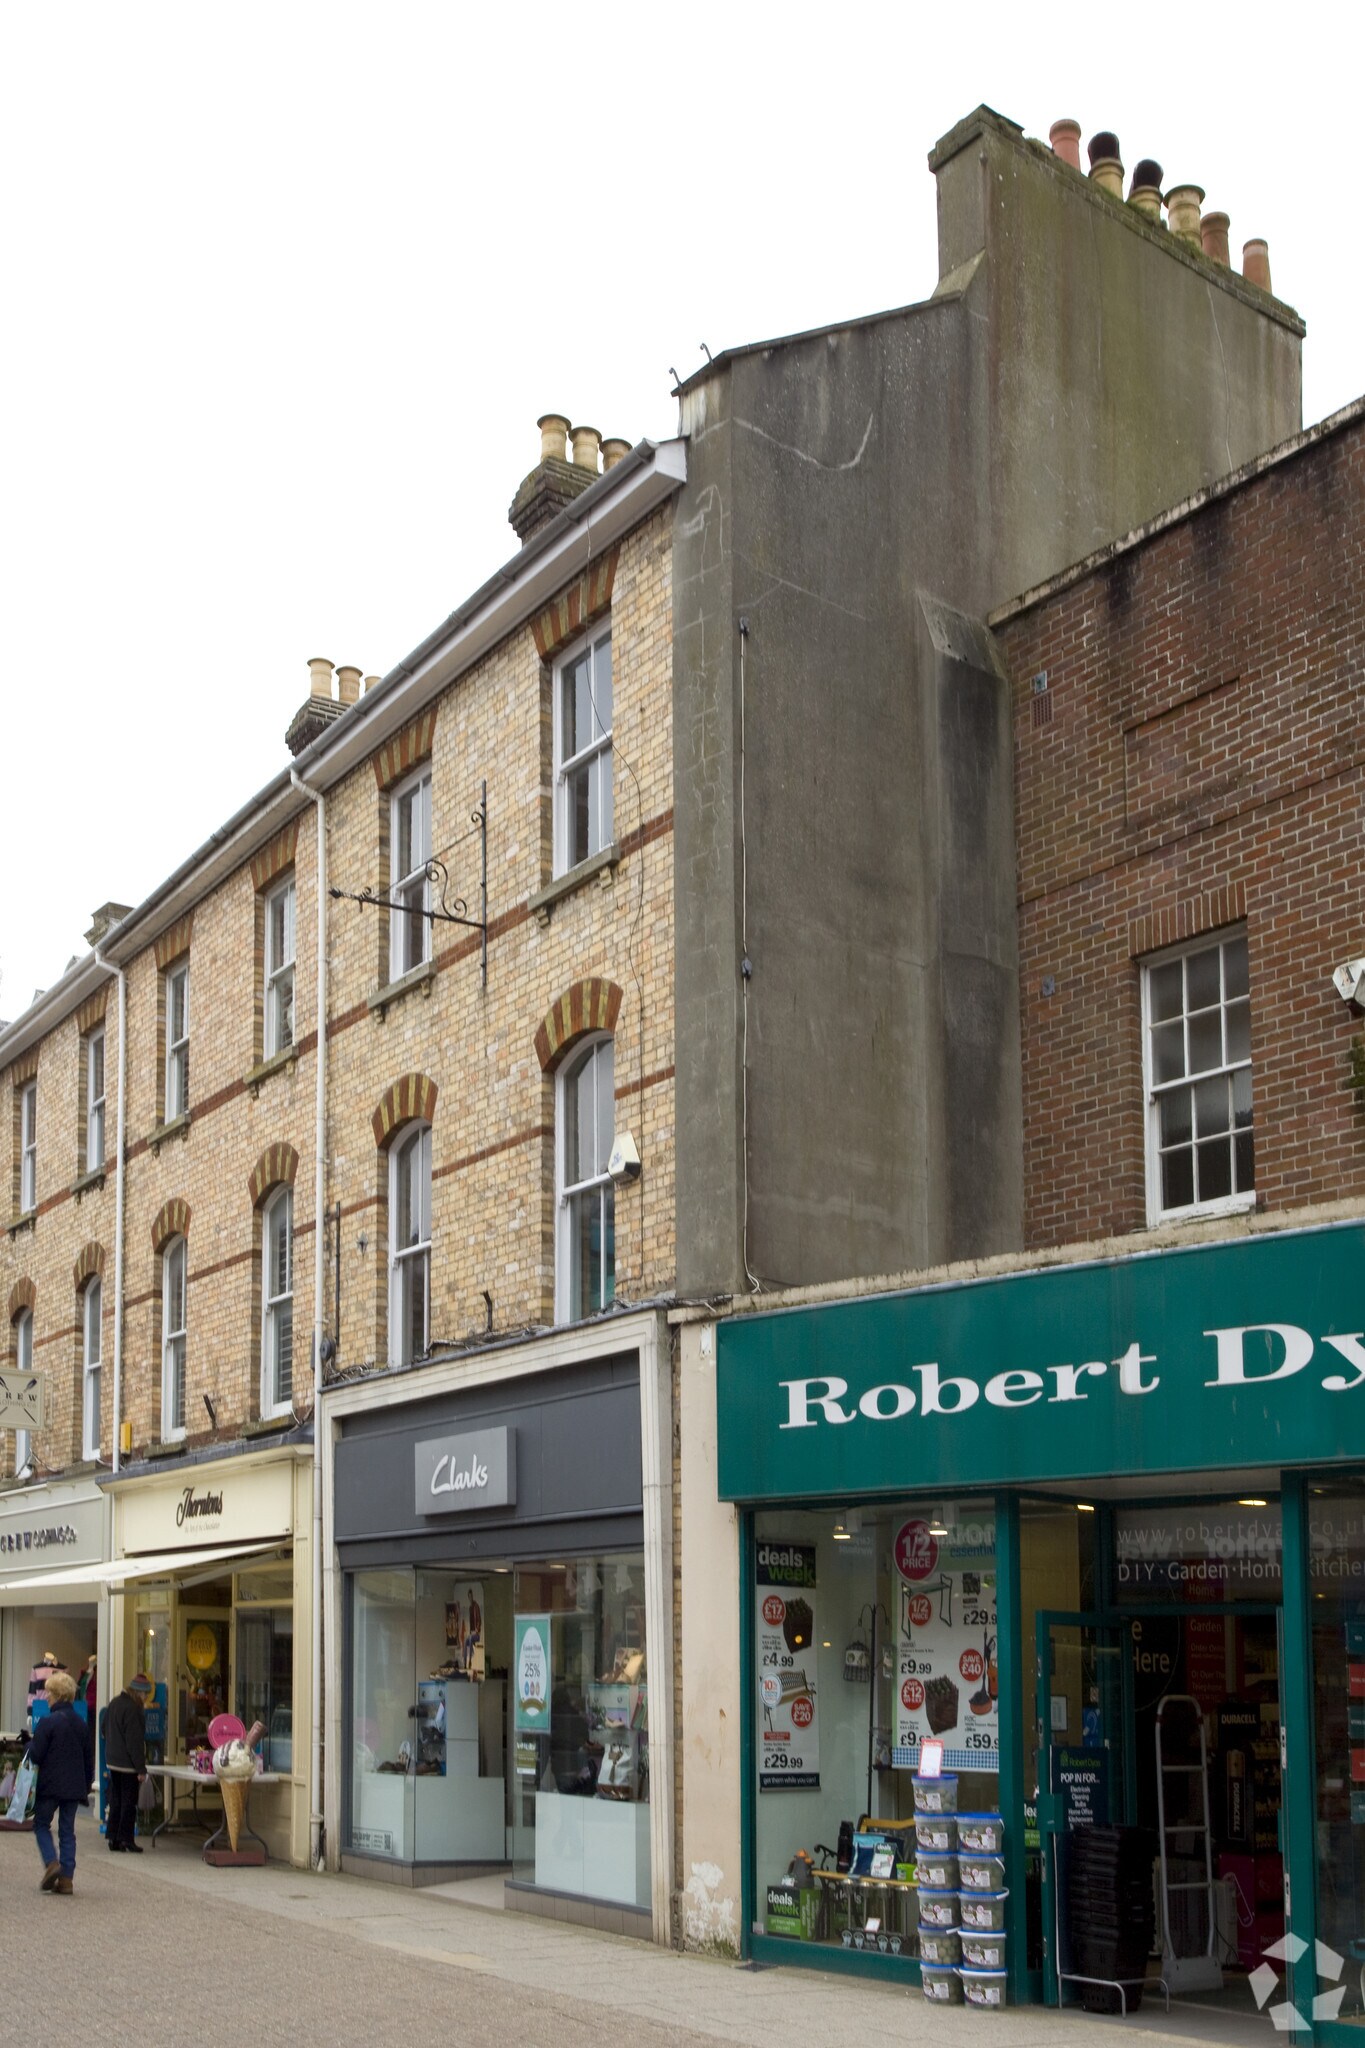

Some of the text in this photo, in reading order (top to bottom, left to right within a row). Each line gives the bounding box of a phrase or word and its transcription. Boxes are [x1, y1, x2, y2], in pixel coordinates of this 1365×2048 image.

[779, 1323, 1365, 1429] Robert Dy
[431, 1454, 488, 1495] Clarks
[176, 1487, 223, 1528] Thorntons
[902, 1534, 930, 1557] 1/2
[759, 1546, 803, 1567] deals
[903, 1556, 931, 1568] PRICE
[768, 1565, 813, 1580] week
[1118, 1557, 1365, 1582] DIY Garden Hom Kitche
[764, 1603, 782, 1615] £17
[911, 1599, 928, 1612] 1/2
[963, 1610, 997, 1625] £29.9
[763, 1652, 794, 1667] £4.99
[963, 1655, 979, 1663] SAVE
[524, 1663, 541, 1677] 25%
[901, 1659, 932, 1674] £9.99
[962, 1663, 981, 1674] £40
[903, 1686, 922, 1696] £12
[794, 1710, 811, 1722] £20
[1221, 1714, 1256, 1725] DURACELL
[965, 1733, 999, 1749] £59.9
[764, 1754, 803, 1768] £29.99
[1060, 1772, 1074, 1784] POP
[1074, 1772, 1082, 1784] IN
[768, 1890, 793, 1906] deals
[773, 1904, 799, 1916] week
